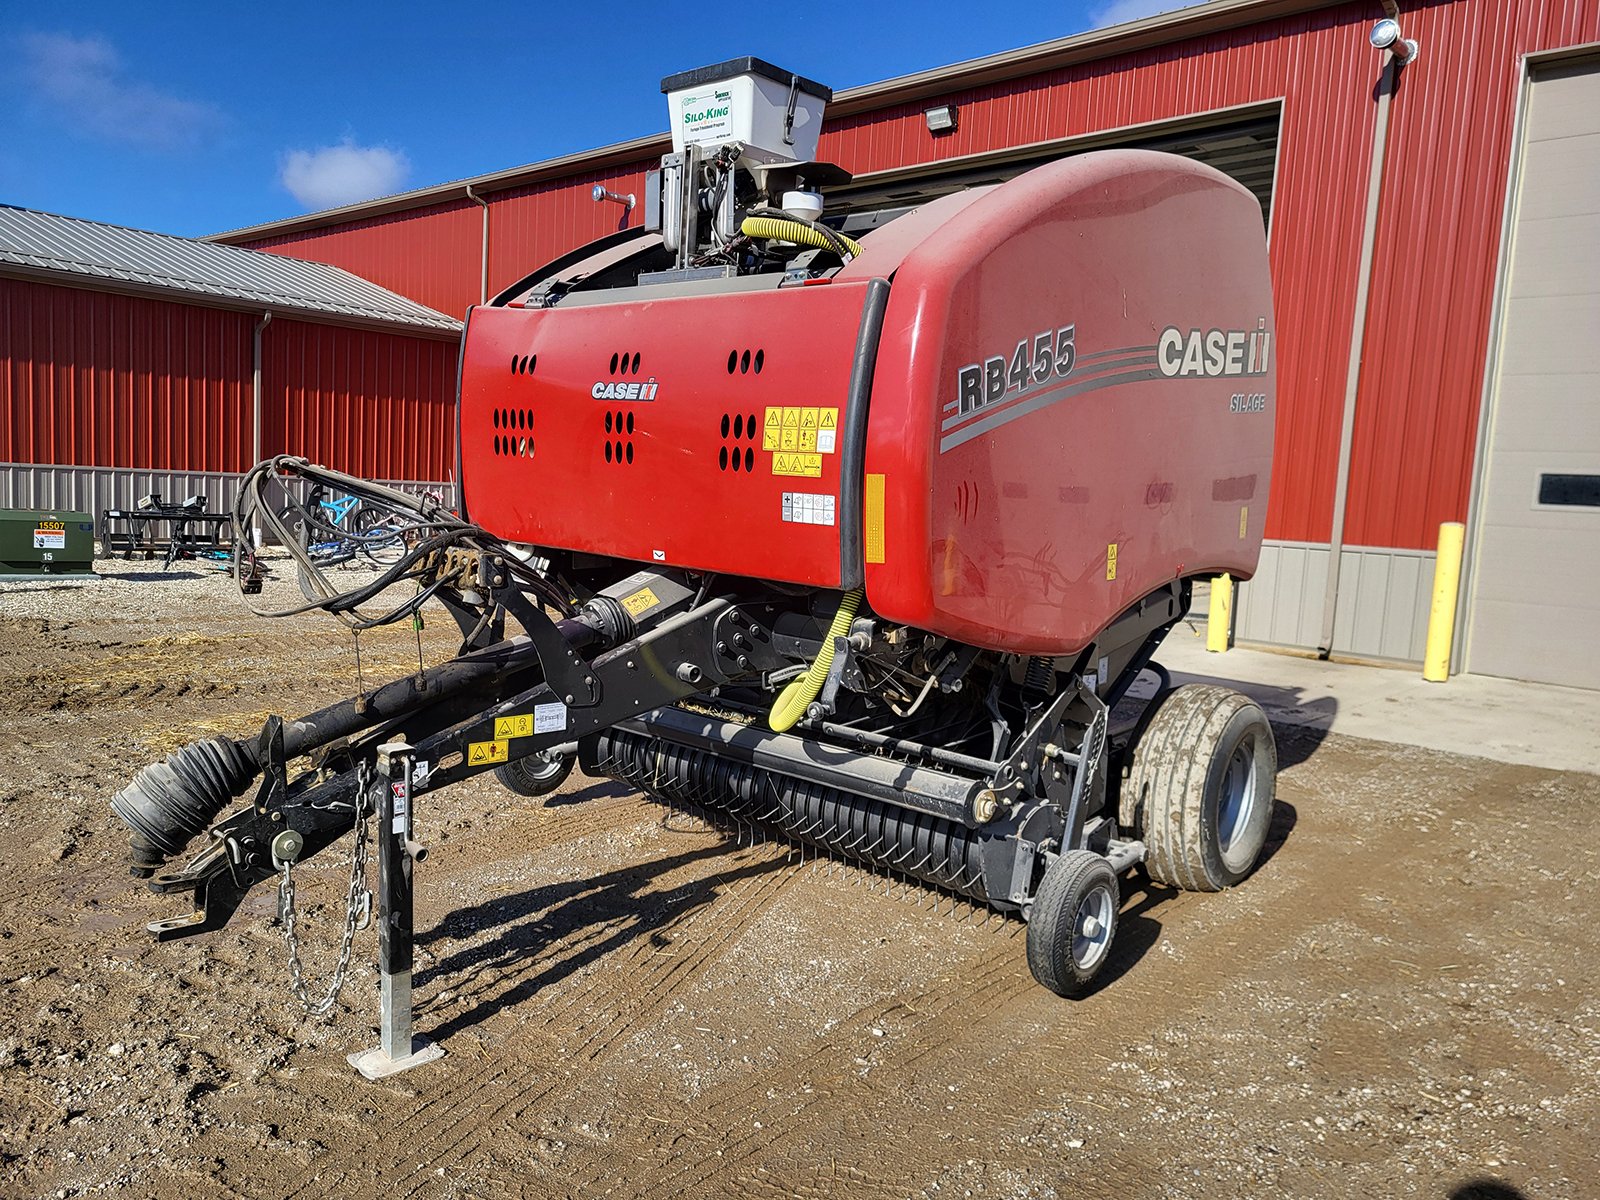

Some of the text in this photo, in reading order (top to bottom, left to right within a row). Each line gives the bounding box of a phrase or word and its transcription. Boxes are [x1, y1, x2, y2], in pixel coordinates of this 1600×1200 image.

[957, 323, 1077, 417] RB455
[1230, 393, 1266, 413] SILAGE
[38, 521, 65, 529] 15507
[42, 552, 53, 561] 15
